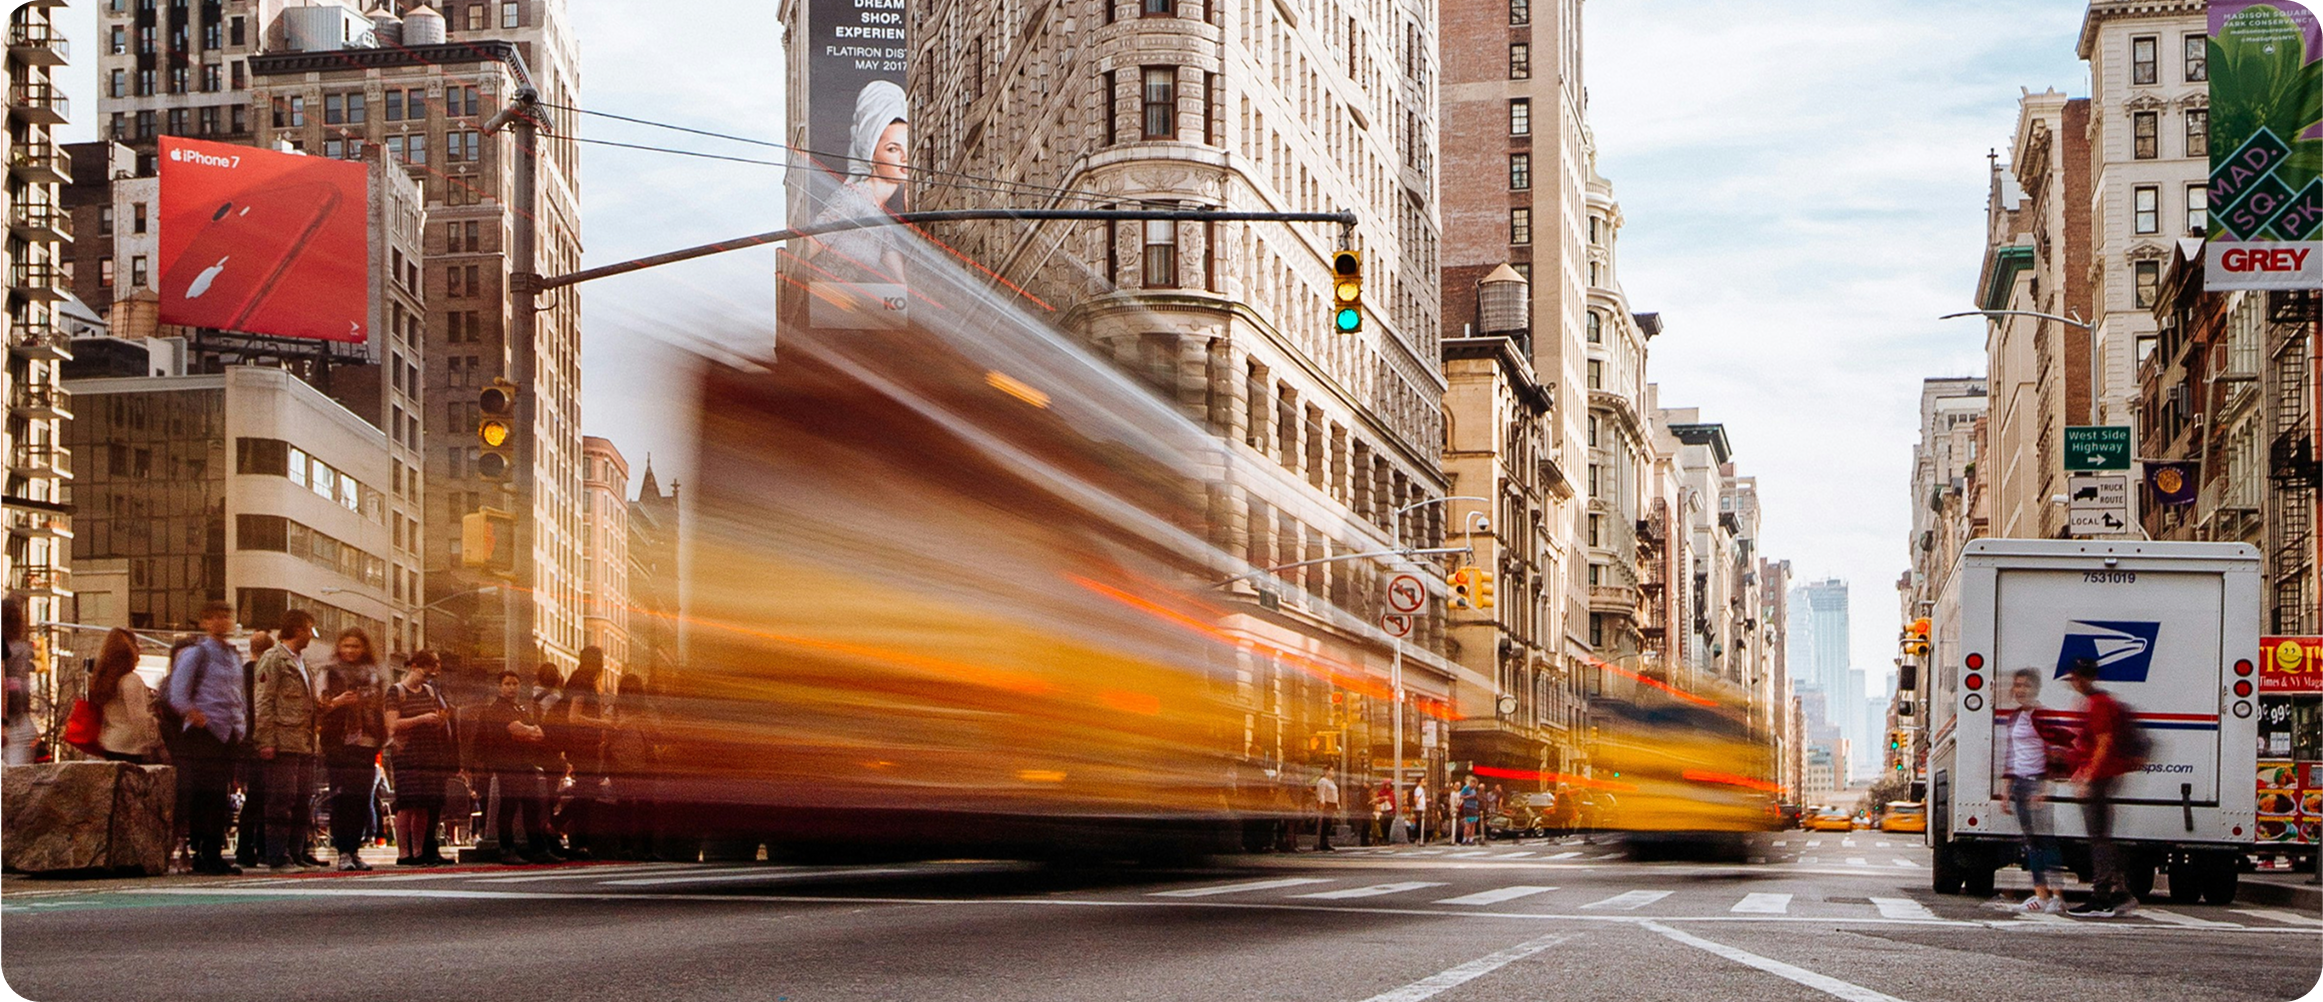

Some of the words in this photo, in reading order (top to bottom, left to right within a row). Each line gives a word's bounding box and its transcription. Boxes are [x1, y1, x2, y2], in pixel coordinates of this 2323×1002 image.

[861, 12, 902, 24] SHOP.
[2223, 11, 2270, 20] MADISON
[2223, 20, 2247, 28] PARK
[2249, 17, 2314, 27] CONSERVANCY
[826, 46, 882, 57] FLATIRON
[885, 48, 908, 59] DIS
[855, 60, 880, 70] MAY
[883, 61, 908, 71] 2017
[183, 149, 230, 168] iPhone
[231, 155, 240, 169] 7
[2208, 147, 2277, 206] MAD.
[2233, 192, 2285, 231] SQ.
[2221, 248, 2311, 272] GREY
[2068, 431, 2097, 440] West
[2101, 430, 2127, 440] Side
[2072, 442, 2123, 454] Highway
[2100, 483, 2124, 491] TRUCK
[2100, 496, 2124, 504] ROUTE
[2071, 517, 2099, 526] LOCAL
[2083, 571, 2136, 584] 7531019
[2260, 675, 2280, 687] Times
[2281, 676, 2288, 687] &
